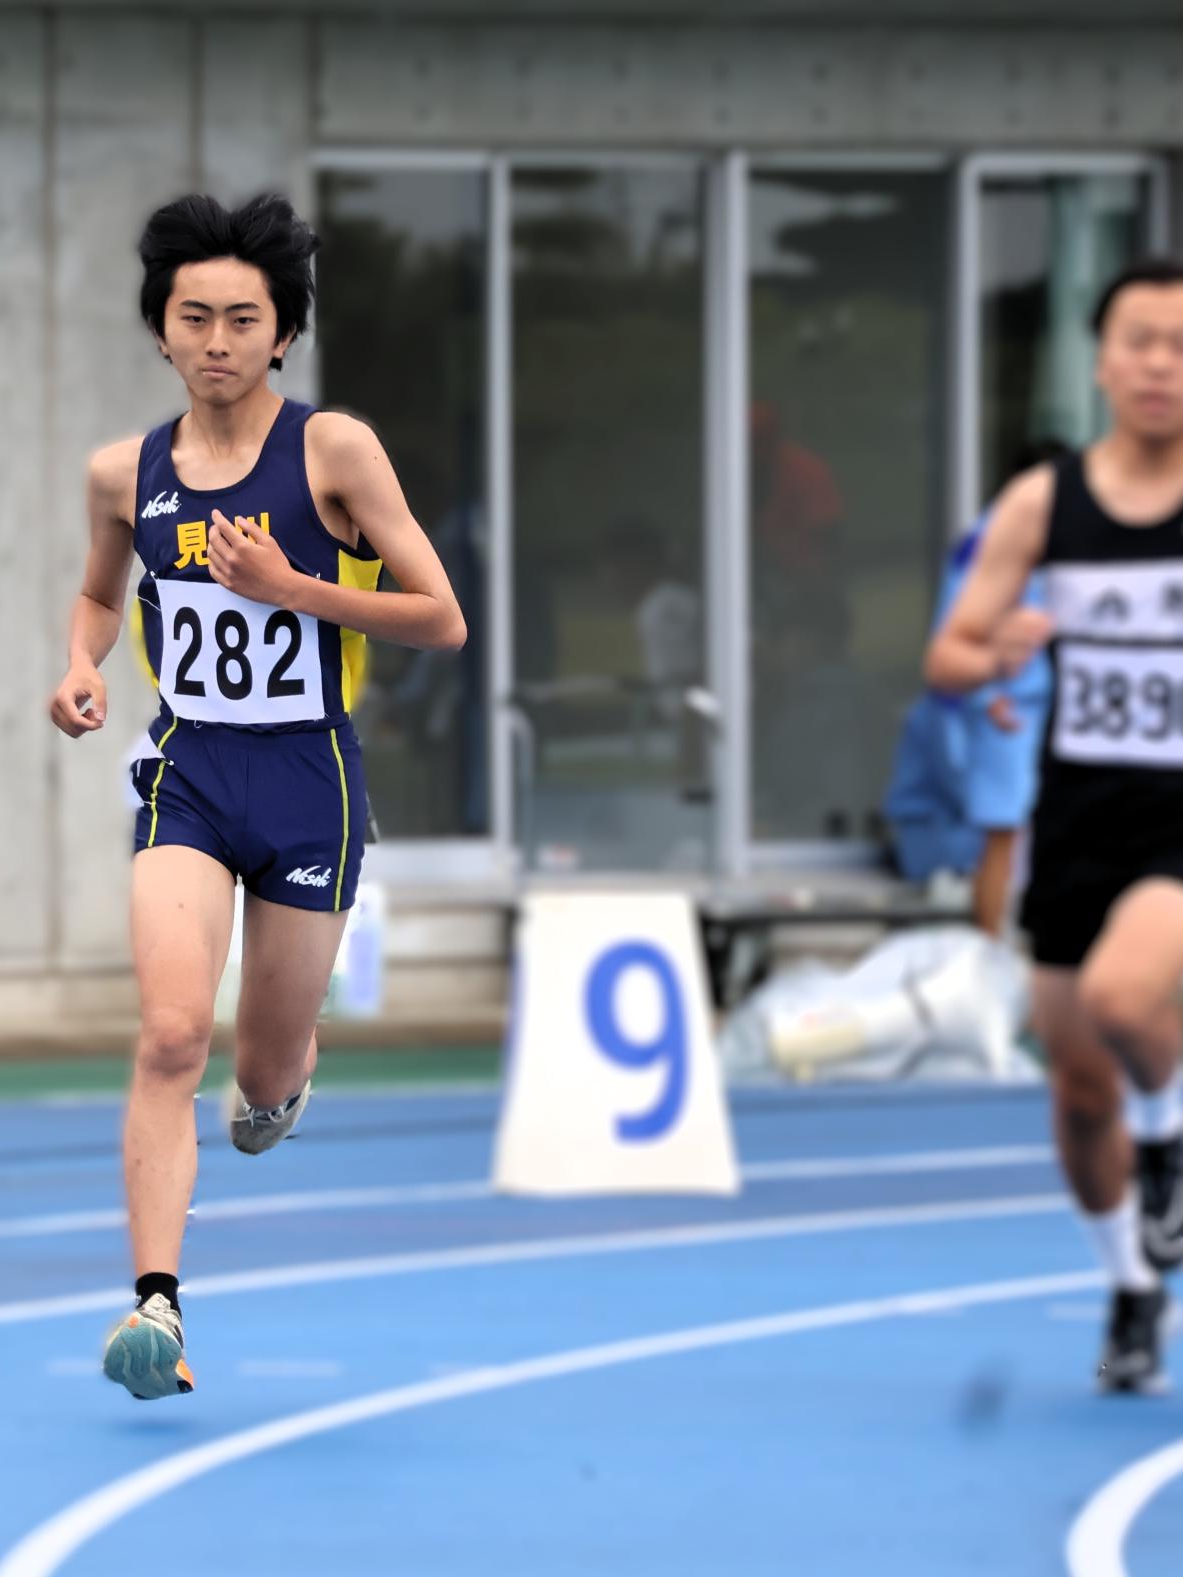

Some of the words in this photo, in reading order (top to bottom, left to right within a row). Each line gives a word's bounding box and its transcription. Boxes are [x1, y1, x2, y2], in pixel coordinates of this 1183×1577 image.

[173, 606, 306, 701] 282
[1068, 665, 1183, 742] 389
[583, 937, 690, 1145] 9
